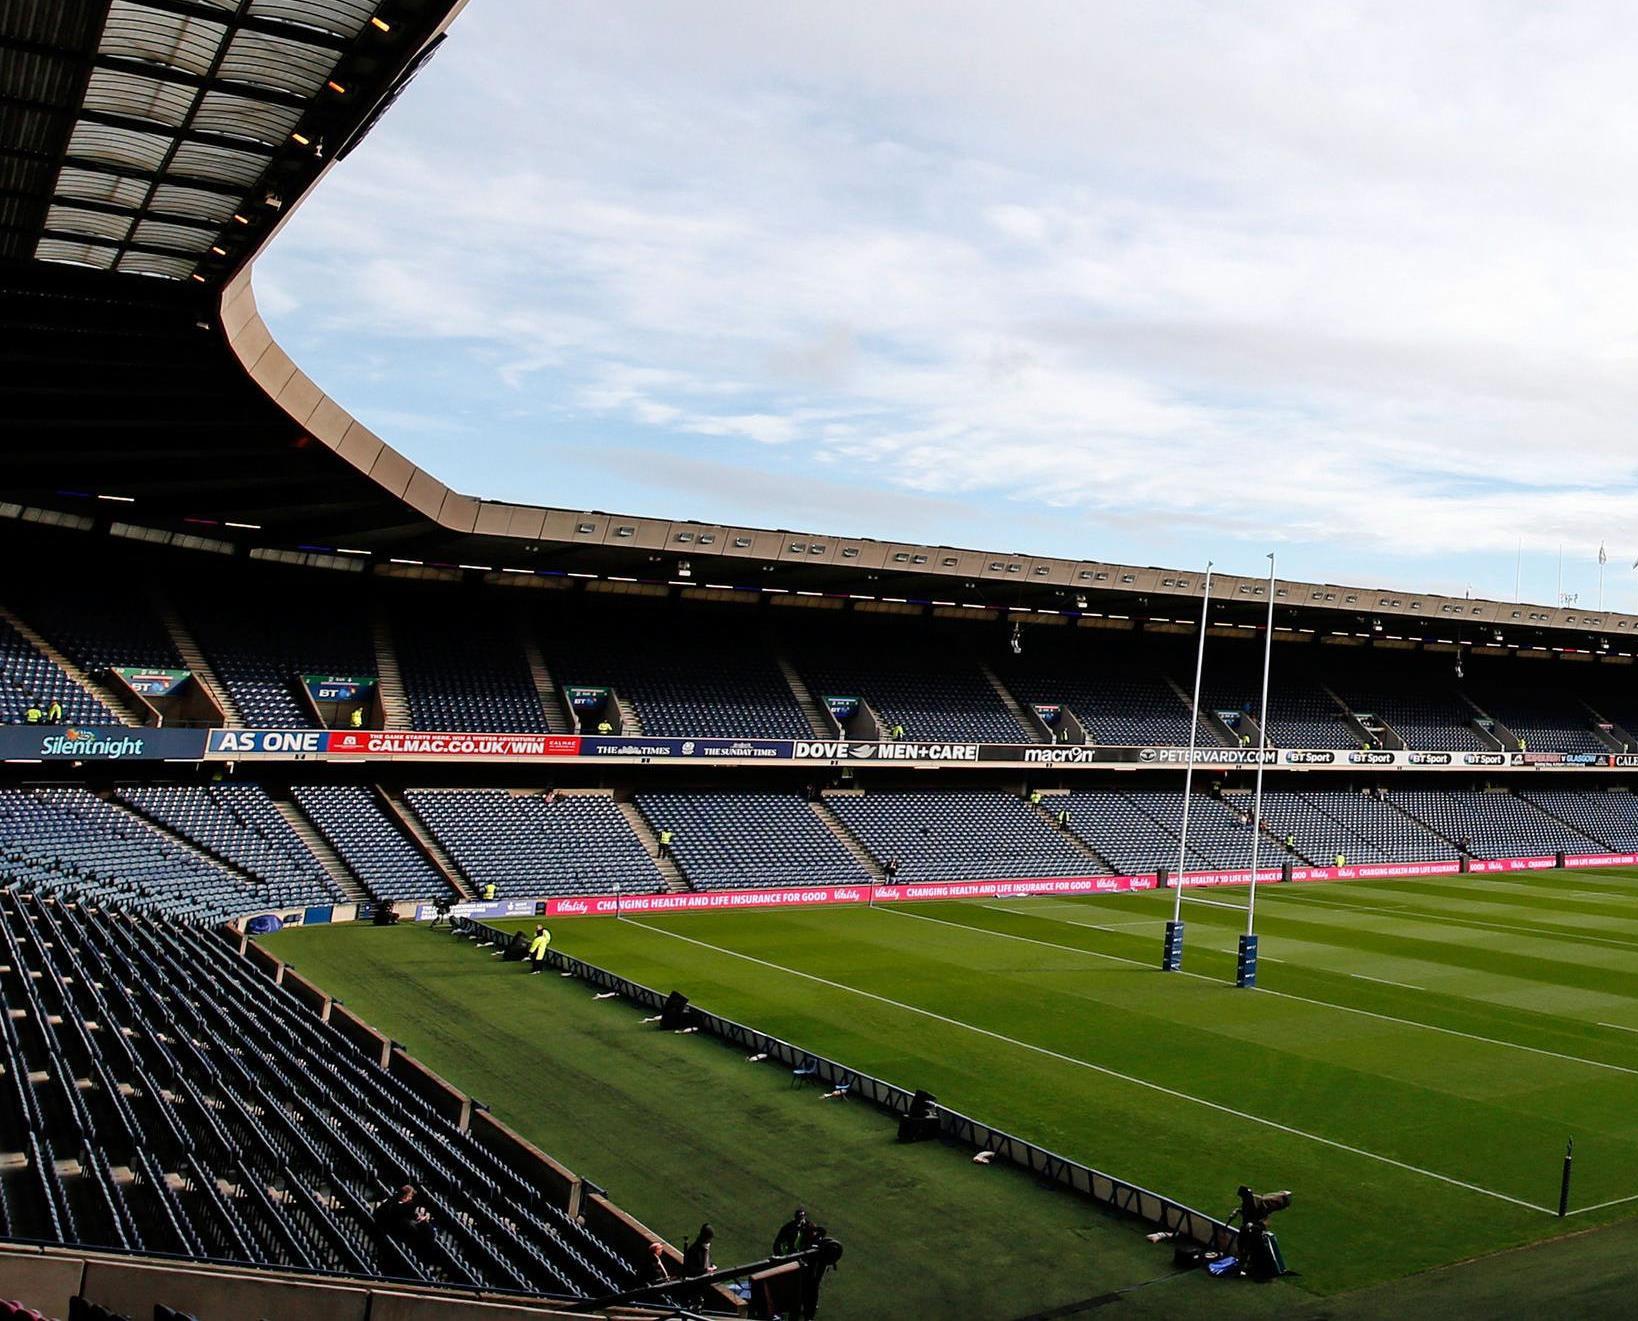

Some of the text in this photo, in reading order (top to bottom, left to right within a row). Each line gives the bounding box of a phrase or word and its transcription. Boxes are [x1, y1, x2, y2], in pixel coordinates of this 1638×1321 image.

[319, 689, 339, 698] BT
[40, 735, 144, 759] Silentnight
[218, 732, 320, 752] AS ONE
[367, 739, 544, 754] CALMAC.CO.UK/WIN
[597, 746, 671, 755] THE TIMES
[704, 748, 720, 756] THE
[796, 743, 976, 760] DOVE MEN+CARE
[1024, 747, 1095, 763] macron
[1159, 750, 1276, 763] PETERVARDY.COM
[1291, 751, 1330, 764] BT Sport
[1354, 752, 1391, 764] BT Sport
[1412, 753, 1448, 765] BT Sport
[1467, 754, 1501, 765] BT Sport
[1567, 754, 1596, 762] GLASGOW
[1191, 875, 1214, 885] HEALTH
[875, 886, 899, 900] Vitality
[906, 888, 948, 897] CHANGING
[949, 886, 978, 896] HEALTH
[979, 885, 996, 893] AND
[997, 884, 1012, 893] LIFE
[1013, 882, 1054, 892] INSURANCE
[1055, 881, 1069, 890] FOR
[1070, 881, 1091, 890] GOOD
[557, 888, 859, 914] Vitality CHANGING HEALTH AND LIFE INSURANCE FOR GOOD Vitality
